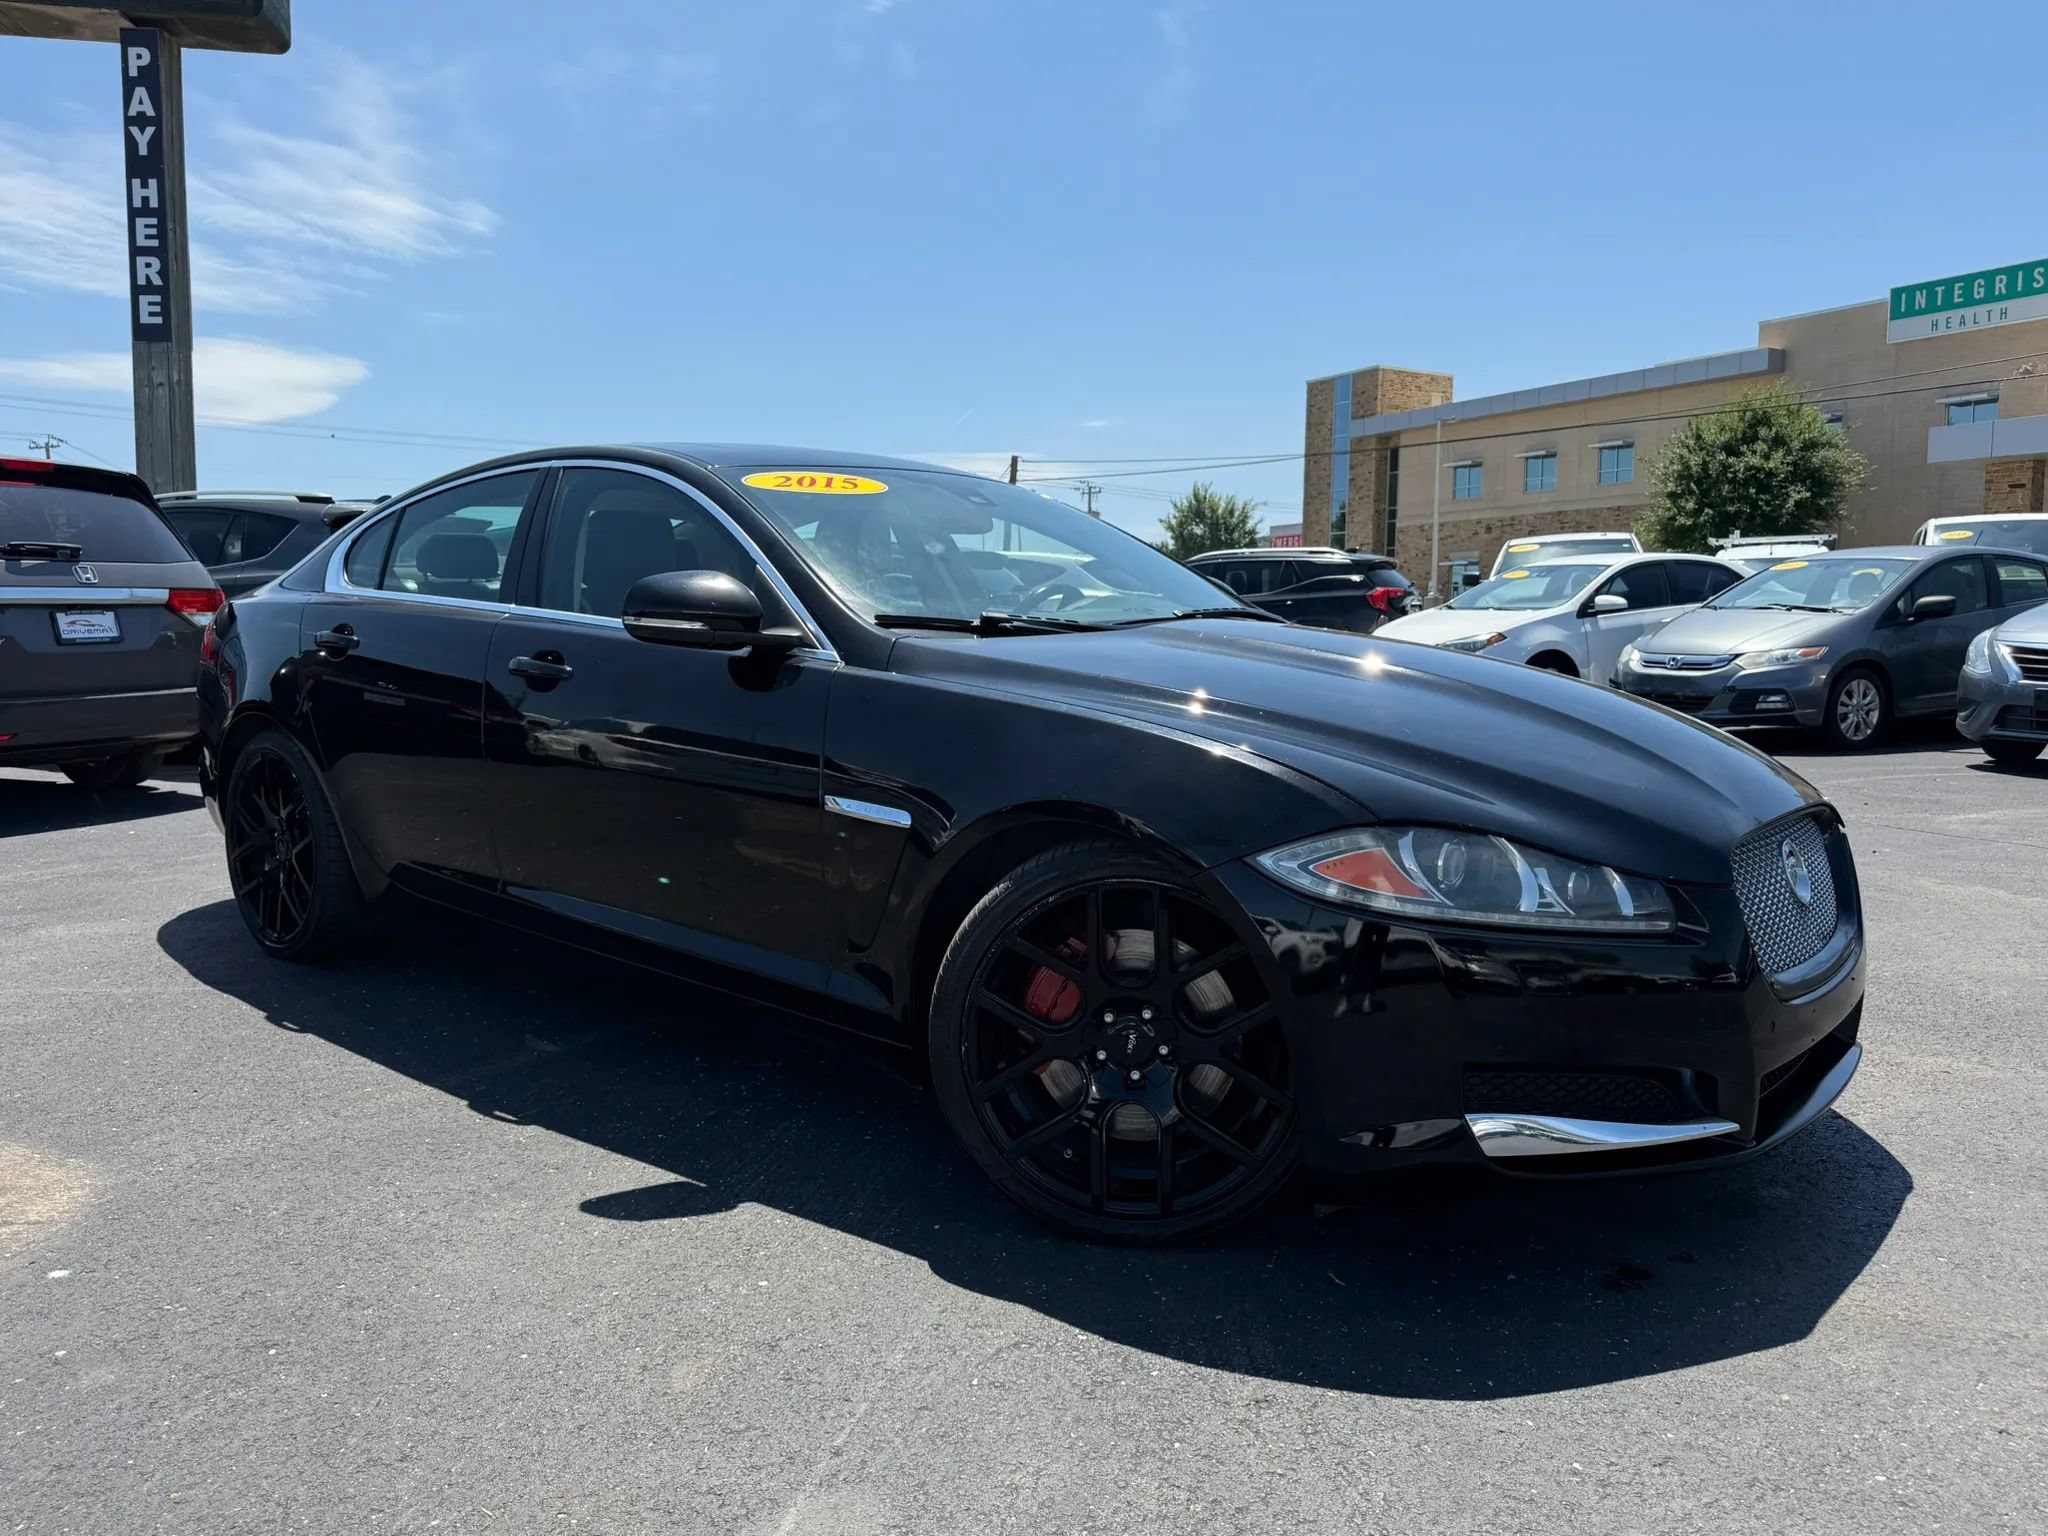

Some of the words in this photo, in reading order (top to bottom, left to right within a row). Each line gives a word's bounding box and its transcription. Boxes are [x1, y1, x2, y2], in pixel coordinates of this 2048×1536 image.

[127, 47, 156, 155] PAY
[131, 178, 163, 324] HERE
[1901, 267, 2045, 312] INTEGRIS
[1931, 307, 2008, 331] HEALTH
[774, 475, 859, 489] 2015
